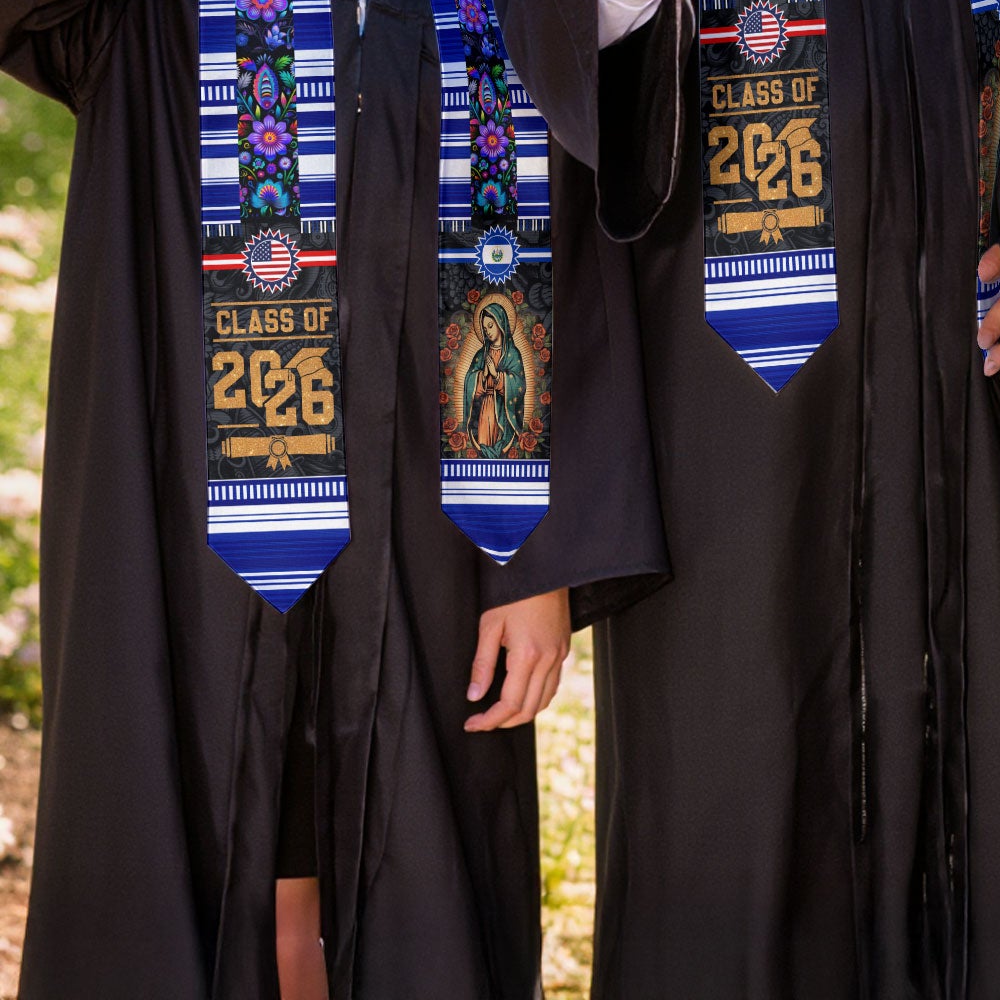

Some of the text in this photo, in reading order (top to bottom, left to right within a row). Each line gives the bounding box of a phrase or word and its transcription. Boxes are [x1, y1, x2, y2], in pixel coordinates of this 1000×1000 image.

[711, 76, 820, 110] CLASS OF
[708, 120, 823, 201] 2026
[216, 306, 333, 335] CLASS OF
[212, 349, 335, 427] 2026
